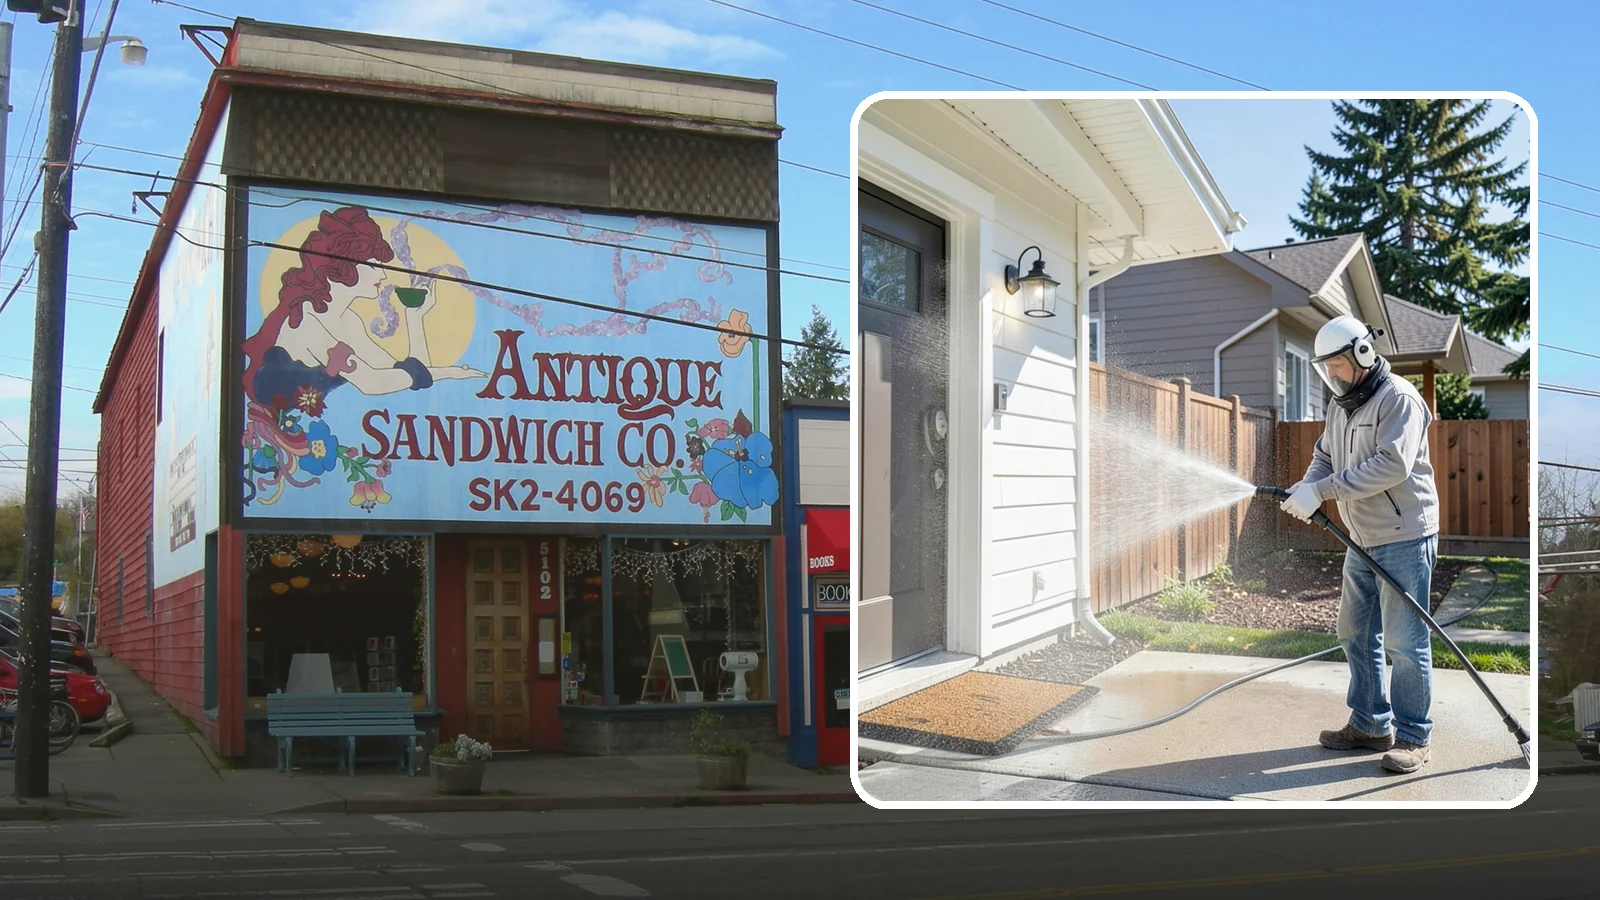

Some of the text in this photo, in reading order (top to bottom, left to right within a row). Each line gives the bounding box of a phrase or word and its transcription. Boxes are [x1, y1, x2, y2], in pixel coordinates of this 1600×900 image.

[475, 329, 724, 421] ANTIQUE
[361, 408, 686, 469] SANDWICH CO.
[468, 476, 646, 514] SK2-4069
[540, 541, 552, 600] 5102
[809, 555, 835, 569] BOOKS
